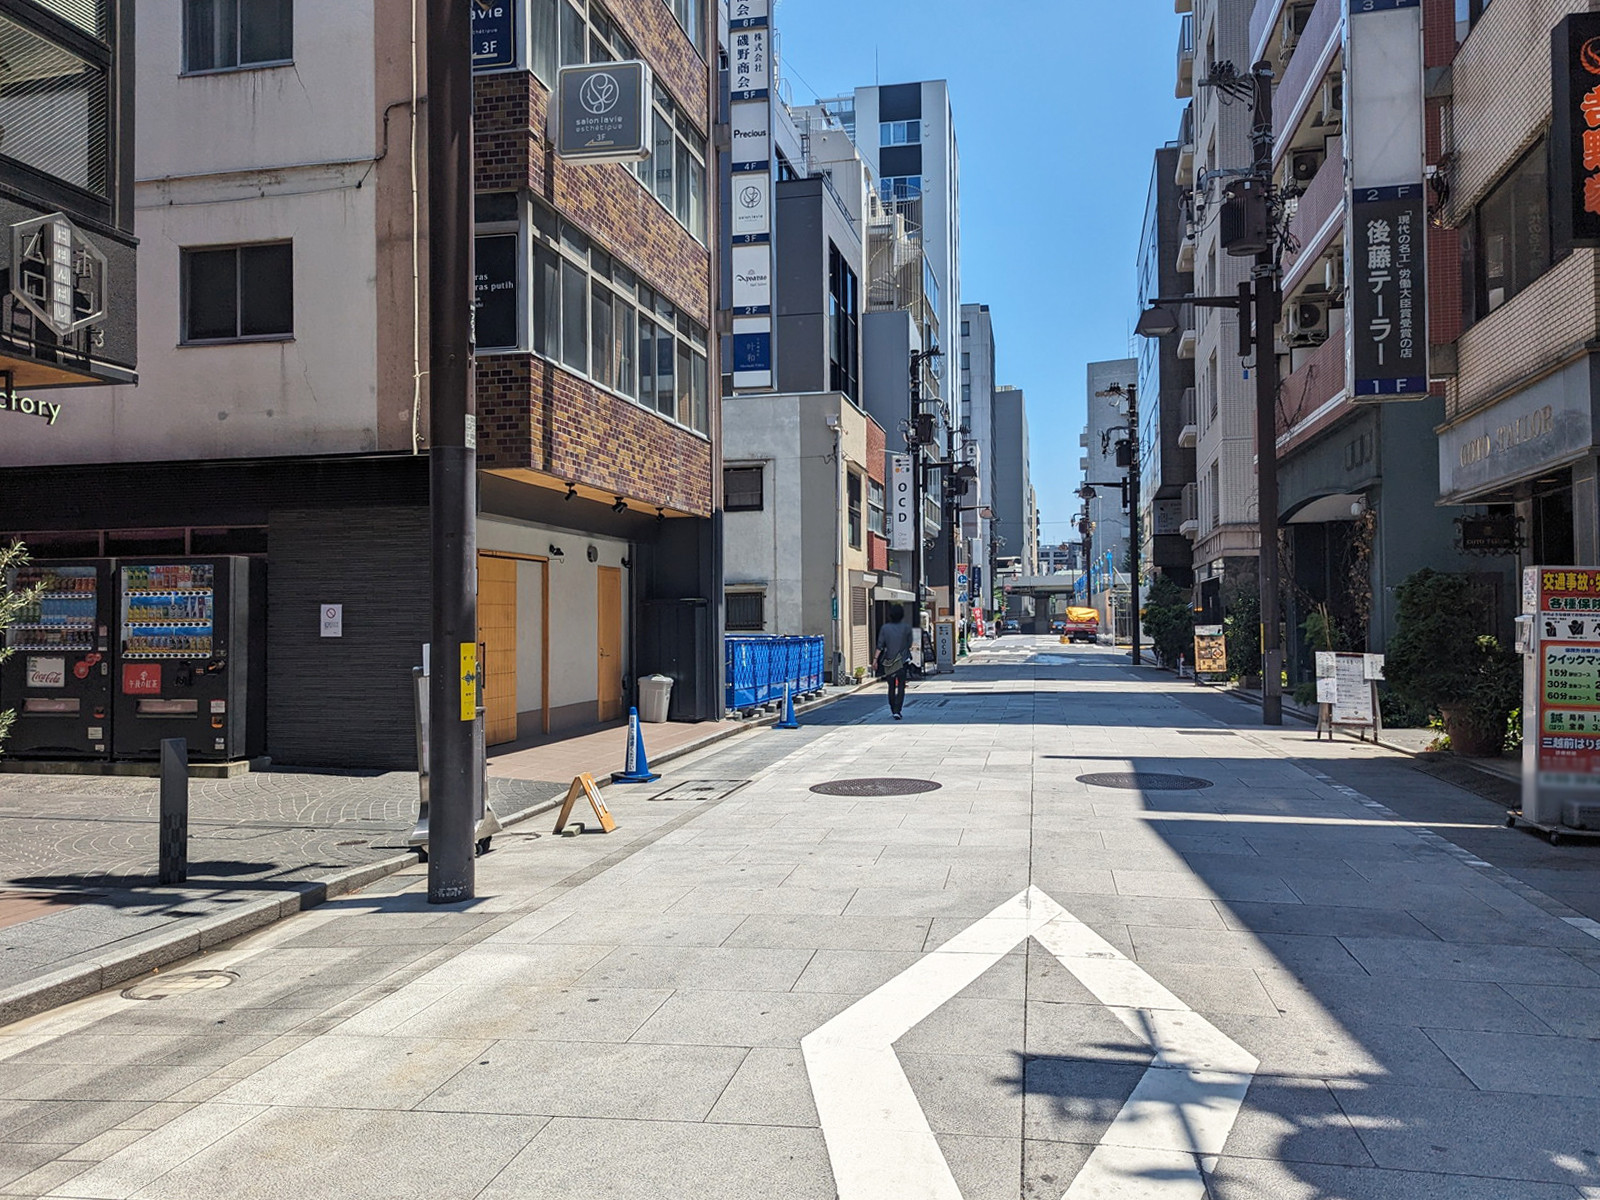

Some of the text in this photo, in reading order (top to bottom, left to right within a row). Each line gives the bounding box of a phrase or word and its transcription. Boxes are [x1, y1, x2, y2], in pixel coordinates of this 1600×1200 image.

[737, 0, 750, 16] 会
[482, 41, 497, 53] 3F
[754, 33, 762, 73] 株式会社
[737, 34, 750, 88] 磯野商会
[743, 90, 756, 99] 5F
[576, 115, 623, 126] salon lavie
[596, 133, 606, 141] 3F
[733, 129, 766, 138] Precious
[744, 162, 757, 170] 4F
[744, 234, 757, 243] 3F
[491, 281, 514, 292] putih
[1367, 220, 1392, 366] 後藤テーラー
[745, 306, 757, 315] 2F
[898, 482, 908, 523] OCD
[1549, 669, 1567, 677] 15分
[1547, 681, 1567, 689] 30分
